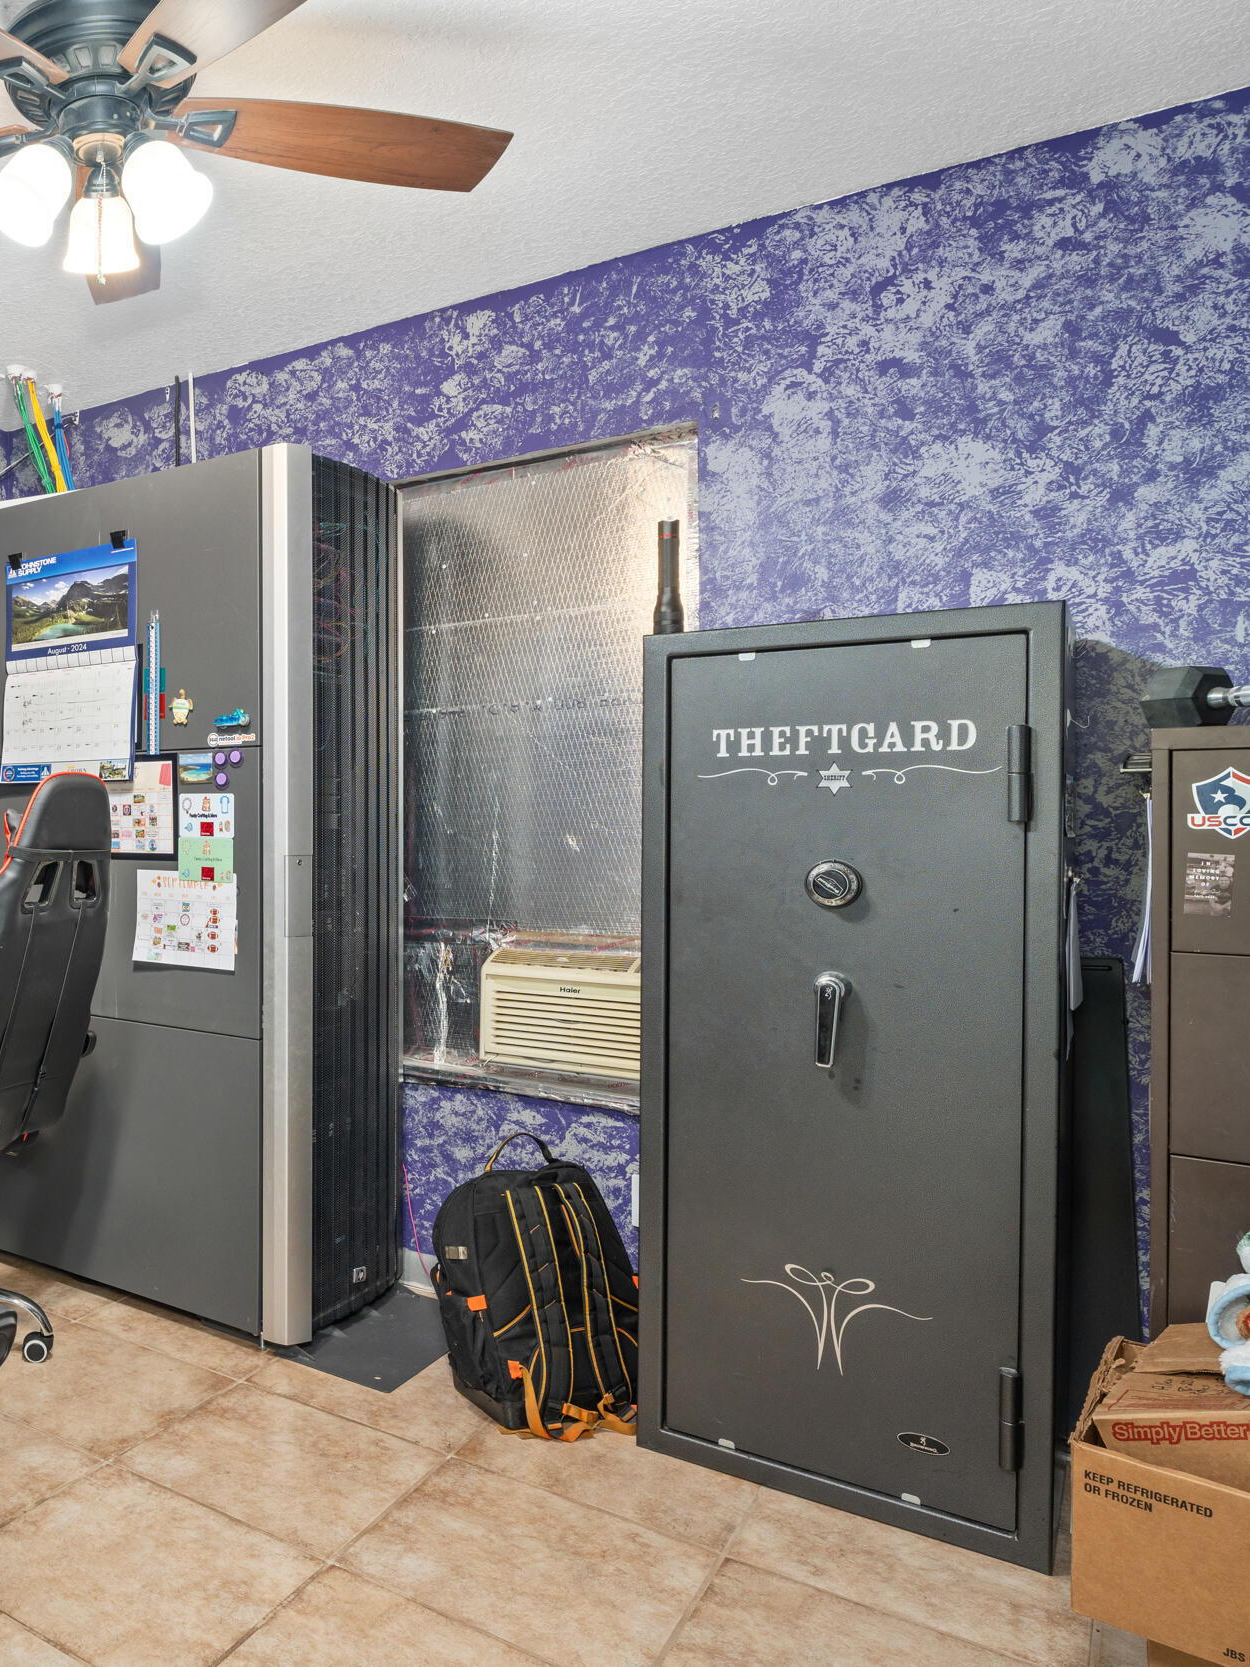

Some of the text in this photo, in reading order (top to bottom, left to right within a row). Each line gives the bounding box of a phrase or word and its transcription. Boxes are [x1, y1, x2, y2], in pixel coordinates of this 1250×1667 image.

[18, 565, 42, 577] SUPPLY
[20, 556, 57, 570] OHNSTONE
[47, 643, 87, 656] August 2024
[712, 719, 977, 757] THEFTGARD
[559, 986, 581, 994] Haier
[1113, 1422, 1182, 1445] Simply
[1083, 1469, 1214, 1519] KEEP REFRIGERATED
[1083, 1483, 1153, 1513] OR FROZEN
[1222, 1647, 1246, 1663] JBS
